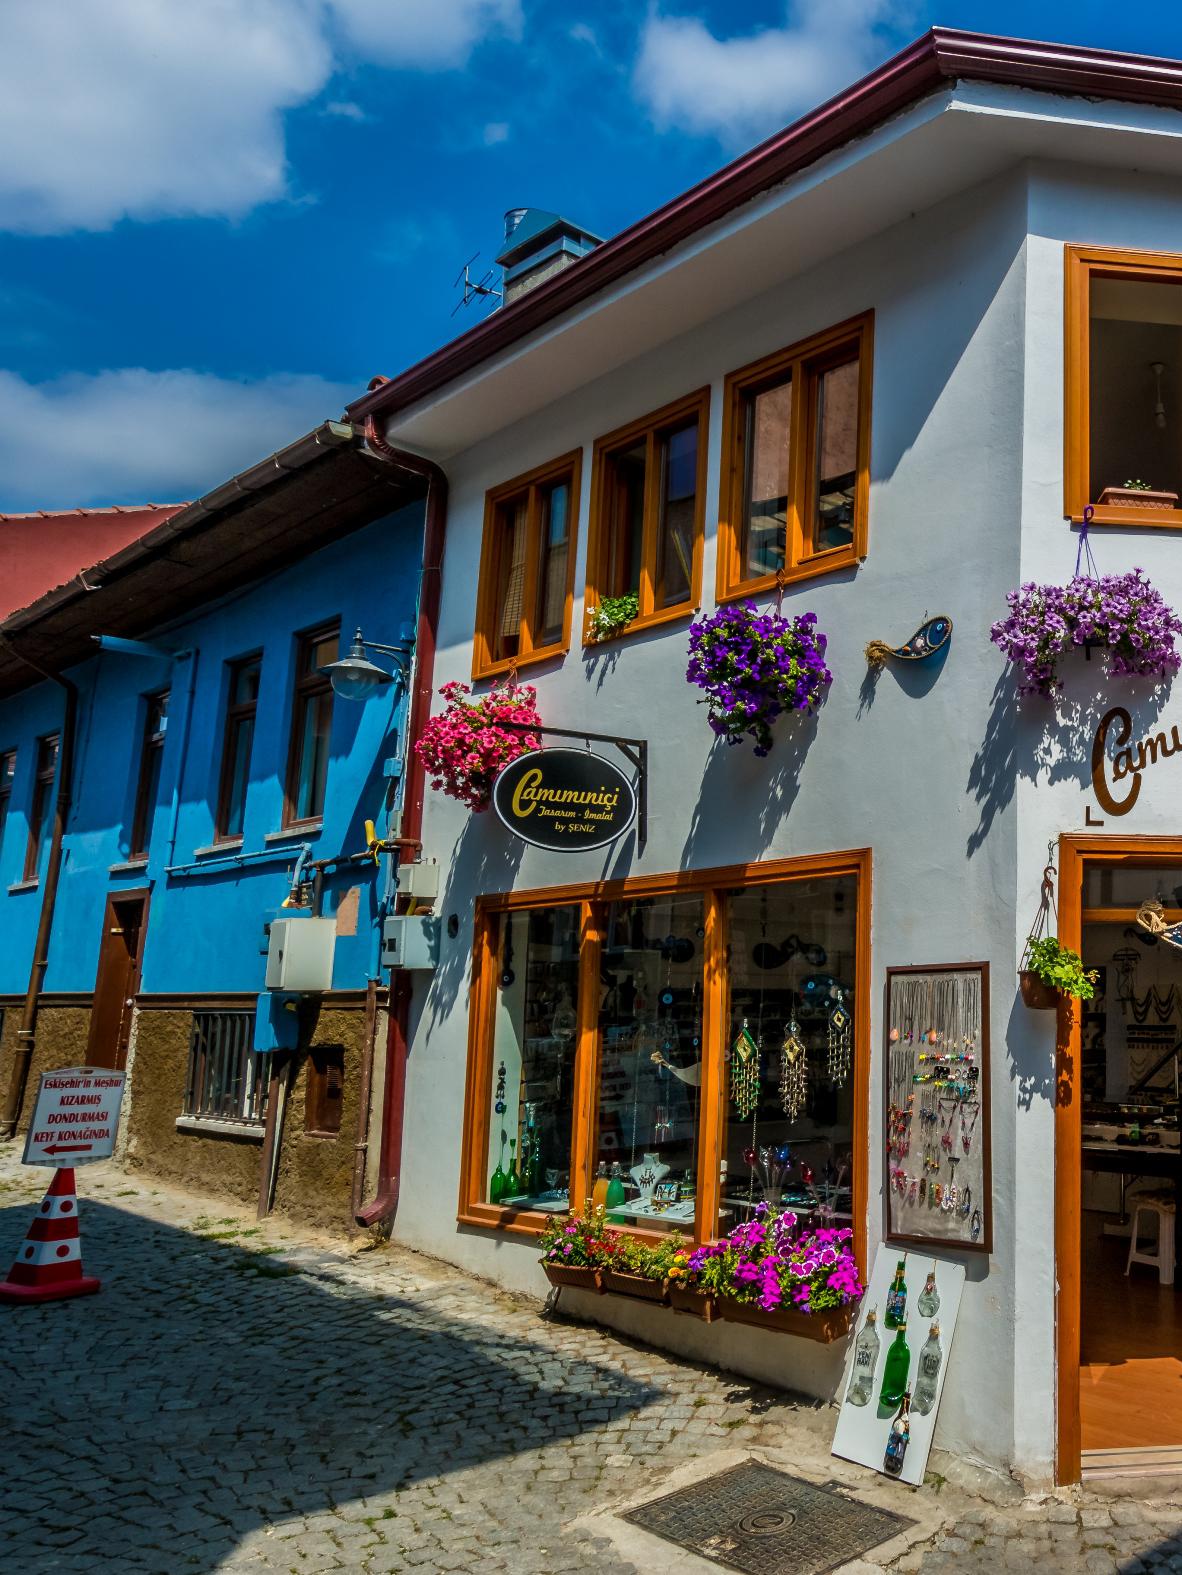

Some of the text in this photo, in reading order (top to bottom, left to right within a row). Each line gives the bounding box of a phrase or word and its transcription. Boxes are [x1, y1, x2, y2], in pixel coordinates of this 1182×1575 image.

[554, 822, 566, 833] by
[94, 1078, 122, 1090] Meşhur
[59, 1094, 102, 1107] KIZARMIŞ
[47, 1111, 109, 1125] DONDURMASI
[33, 1127, 110, 1143] KEYF KONAĞINDA
